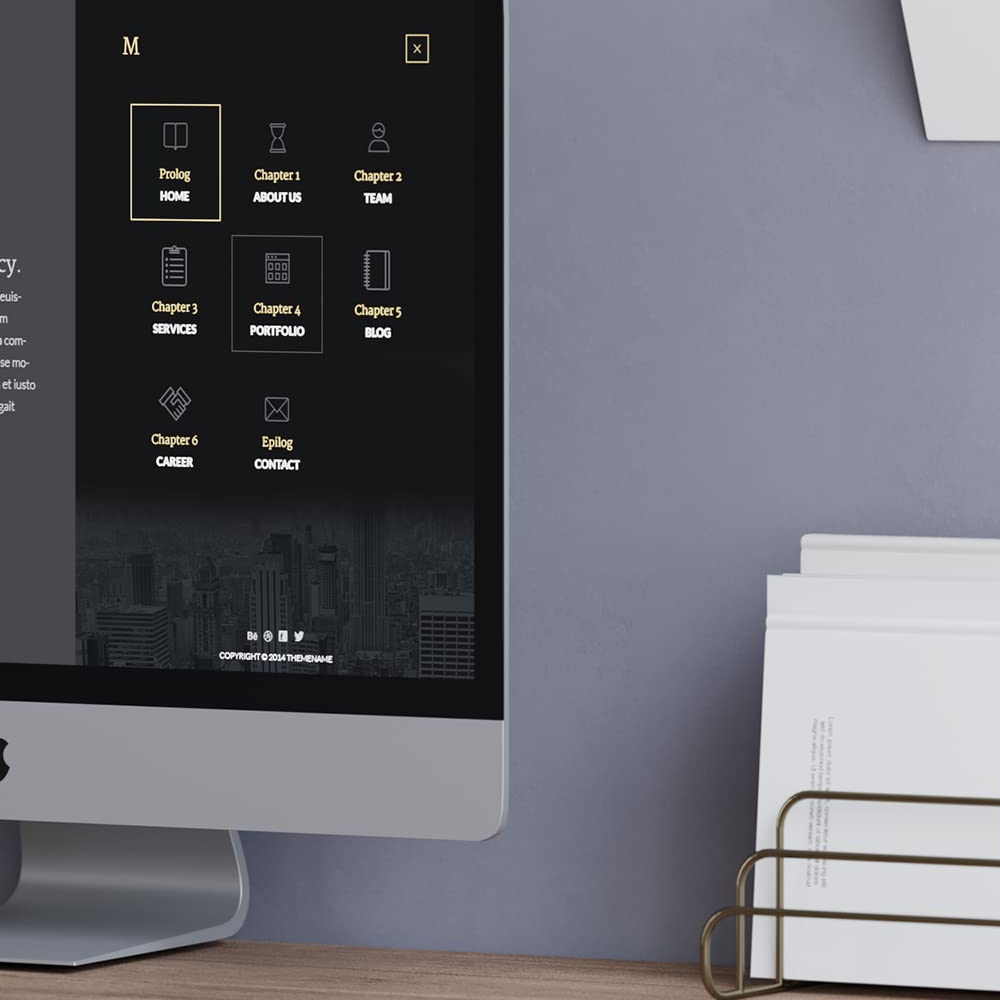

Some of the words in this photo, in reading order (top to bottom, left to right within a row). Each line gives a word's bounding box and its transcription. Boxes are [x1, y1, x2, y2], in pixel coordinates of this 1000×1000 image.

[122, 36, 140, 55] M
[159, 168, 191, 182] Prolog
[254, 169, 294, 183] Chapter
[295, 171, 300, 180] 1
[354, 170, 394, 184] Chapter
[396, 172, 402, 182] 2
[160, 190, 190, 201] HOME
[253, 192, 289, 203] ABOUT
[288, 192, 302, 203] US
[363, 193, 392, 204] TEAM
[152, 301, 191, 315] Chapter
[190, 303, 198, 314] 3
[253, 302, 292, 317] Chapter
[294, 305, 301, 316] 4
[354, 304, 394, 319] Chapter
[396, 307, 402, 318] 5
[152, 323, 197, 335] SERVICES
[250, 325, 305, 337] PORTFOLIO
[365, 327, 391, 338] BLOG
[4, 337, 27, 346] com-
[12, 358, 30, 368] mo-
[2, 379, 12, 390] et
[13, 379, 36, 390] iusto
[151, 433, 190, 448] Chapter
[192, 435, 198, 446] 6
[262, 436, 293, 451] Epilog
[156, 456, 194, 468] CAREER
[254, 458, 301, 470] CONTACT
[219, 651, 260, 661] COPYRIGHT
[268, 653, 286, 661] 2014
[286, 653, 333, 663] THEMENAME
